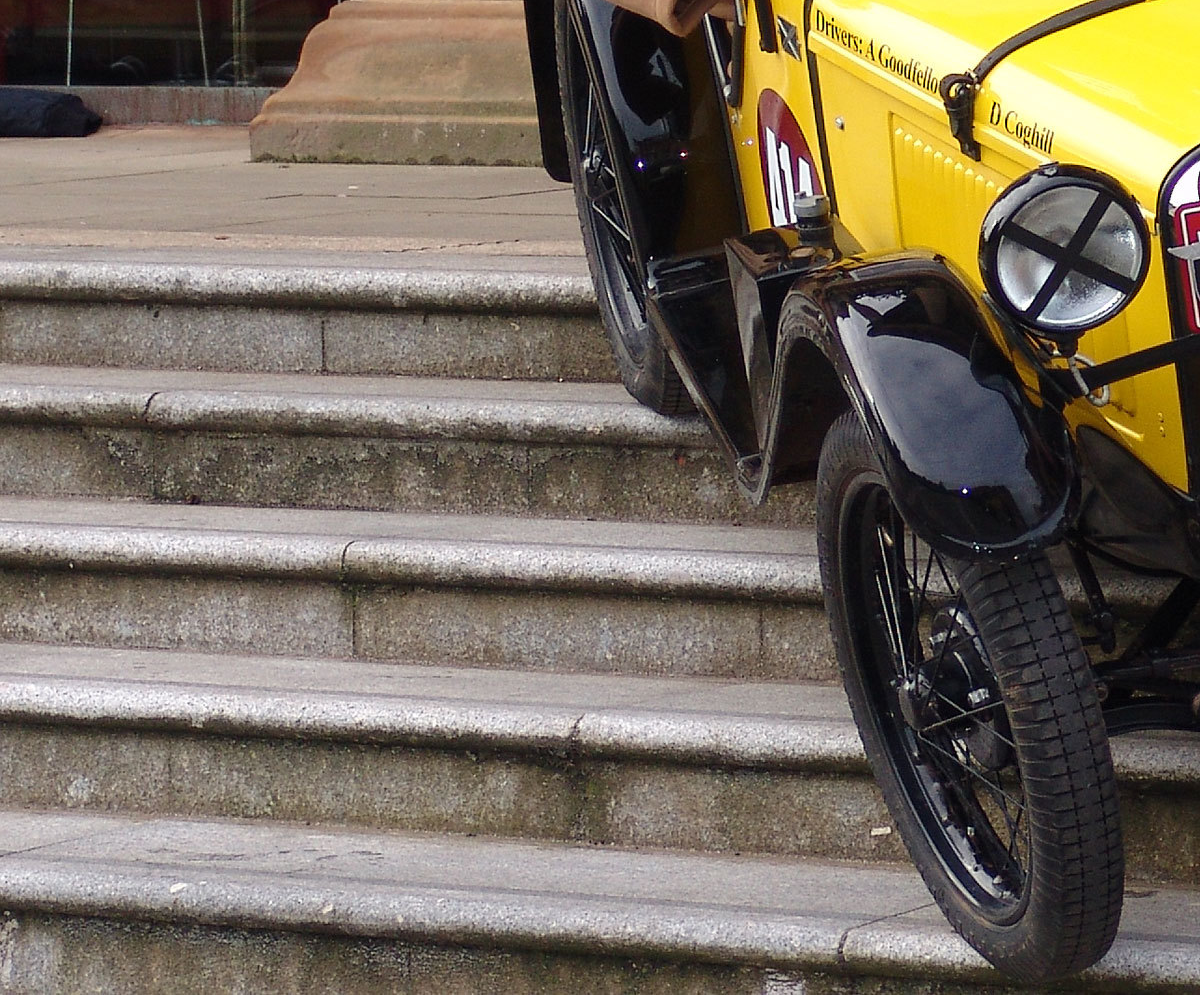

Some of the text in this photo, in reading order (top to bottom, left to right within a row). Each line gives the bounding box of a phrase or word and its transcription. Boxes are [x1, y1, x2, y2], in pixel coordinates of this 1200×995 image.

[816, 8, 863, 54] Drivers:
[865, 44, 876, 60] A
[989, 101, 1054, 154] D Coghill
